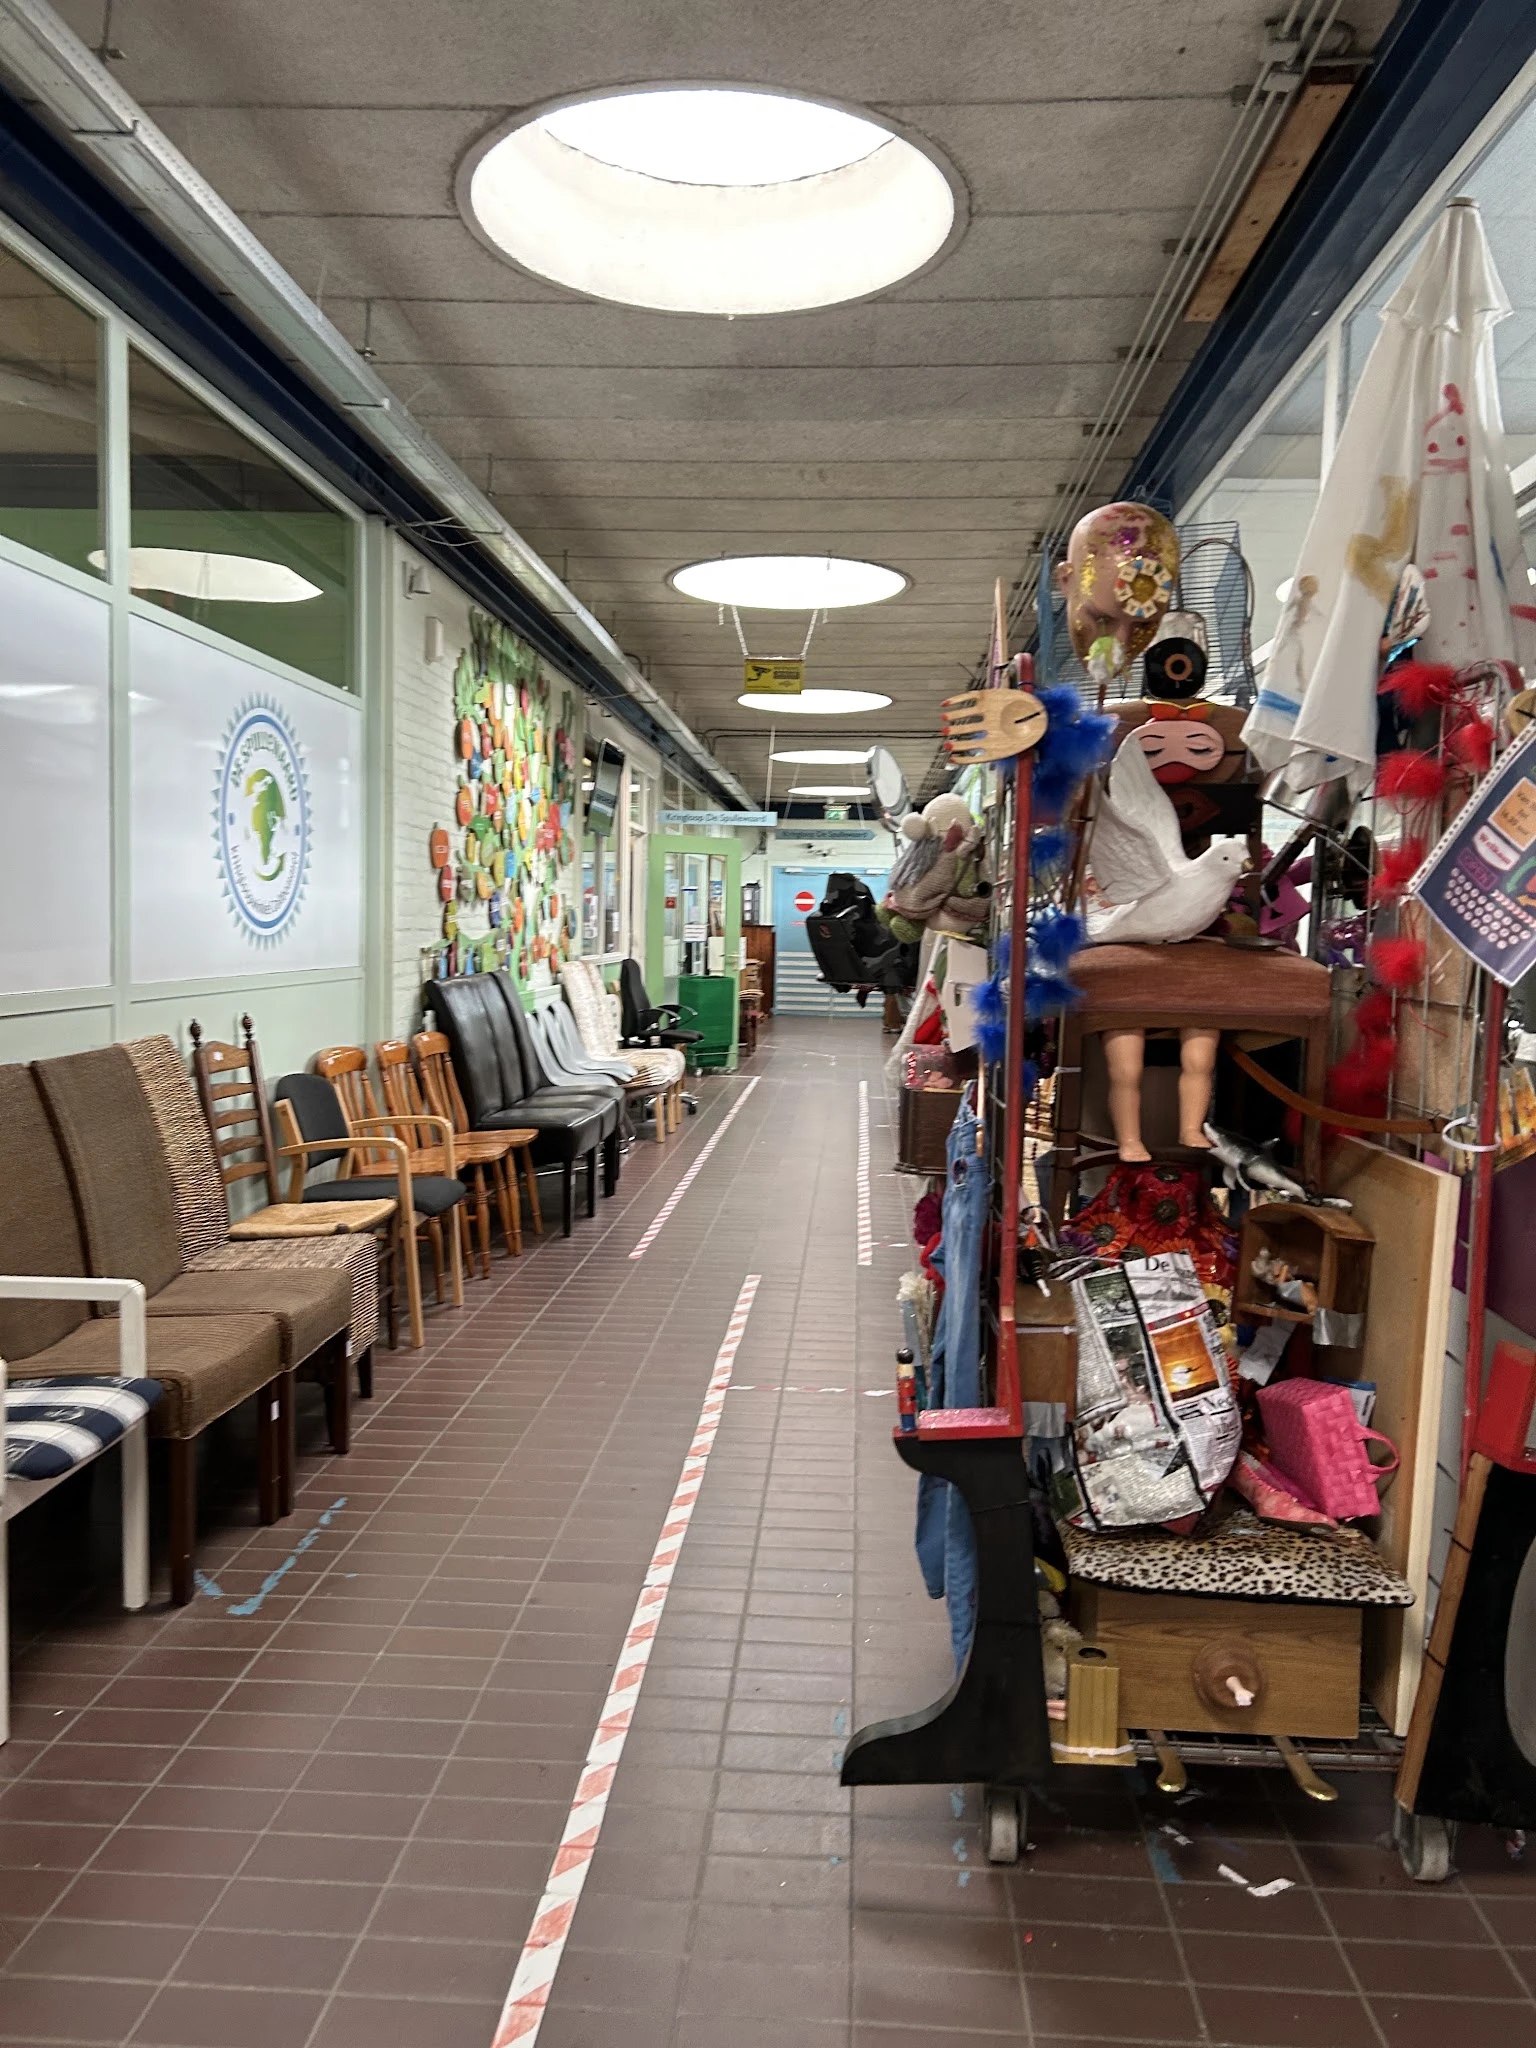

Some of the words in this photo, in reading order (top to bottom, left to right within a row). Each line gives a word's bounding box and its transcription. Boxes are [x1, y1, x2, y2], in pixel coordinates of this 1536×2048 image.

[665, 813, 704, 823] Kringloop
[706, 813, 718, 822] De
[1145, 1256, 1170, 1272] De
